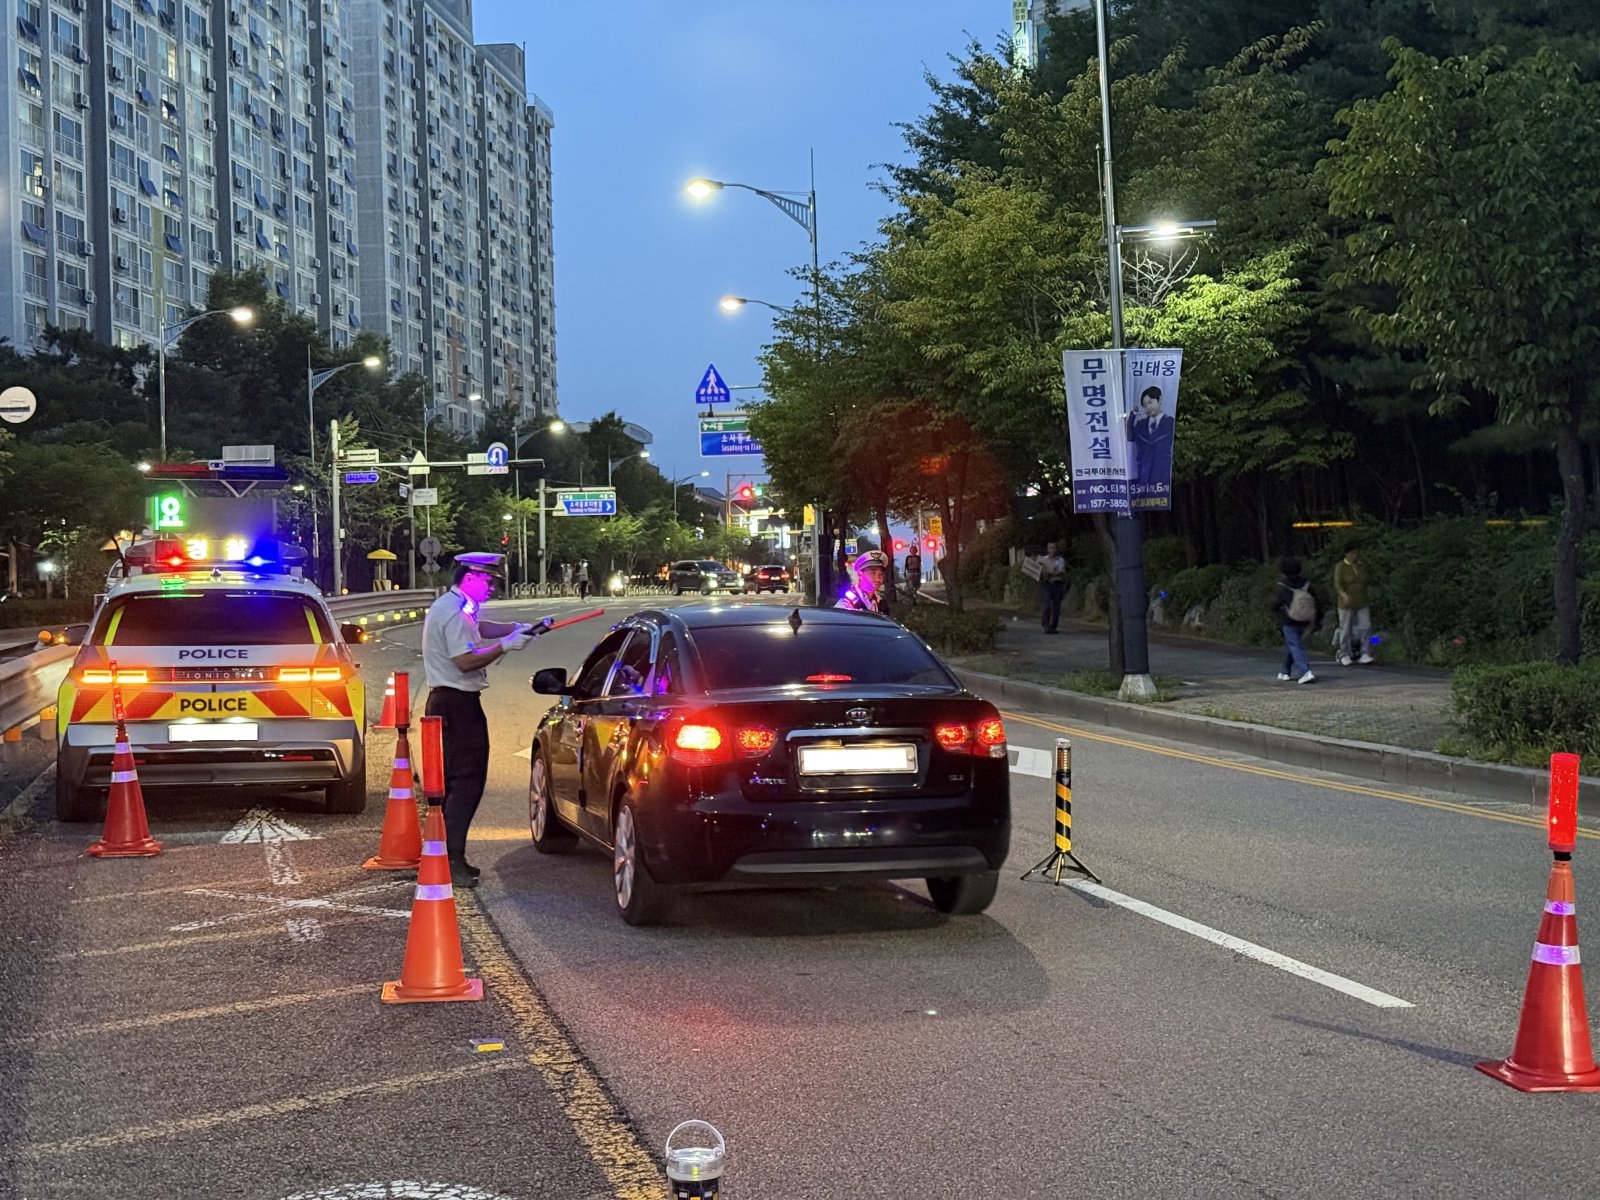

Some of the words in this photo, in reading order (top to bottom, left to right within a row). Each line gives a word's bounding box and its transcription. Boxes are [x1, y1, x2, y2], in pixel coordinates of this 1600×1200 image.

[1131, 360, 1176, 377] 김태웅
[1081, 358, 1112, 460] 무명전설
[1090, 498, 1128, 509] 1577-3850
[178, 648, 249, 660] POLICE
[186, 672, 230, 680] IONIQ
[179, 697, 248, 712] POLICE
